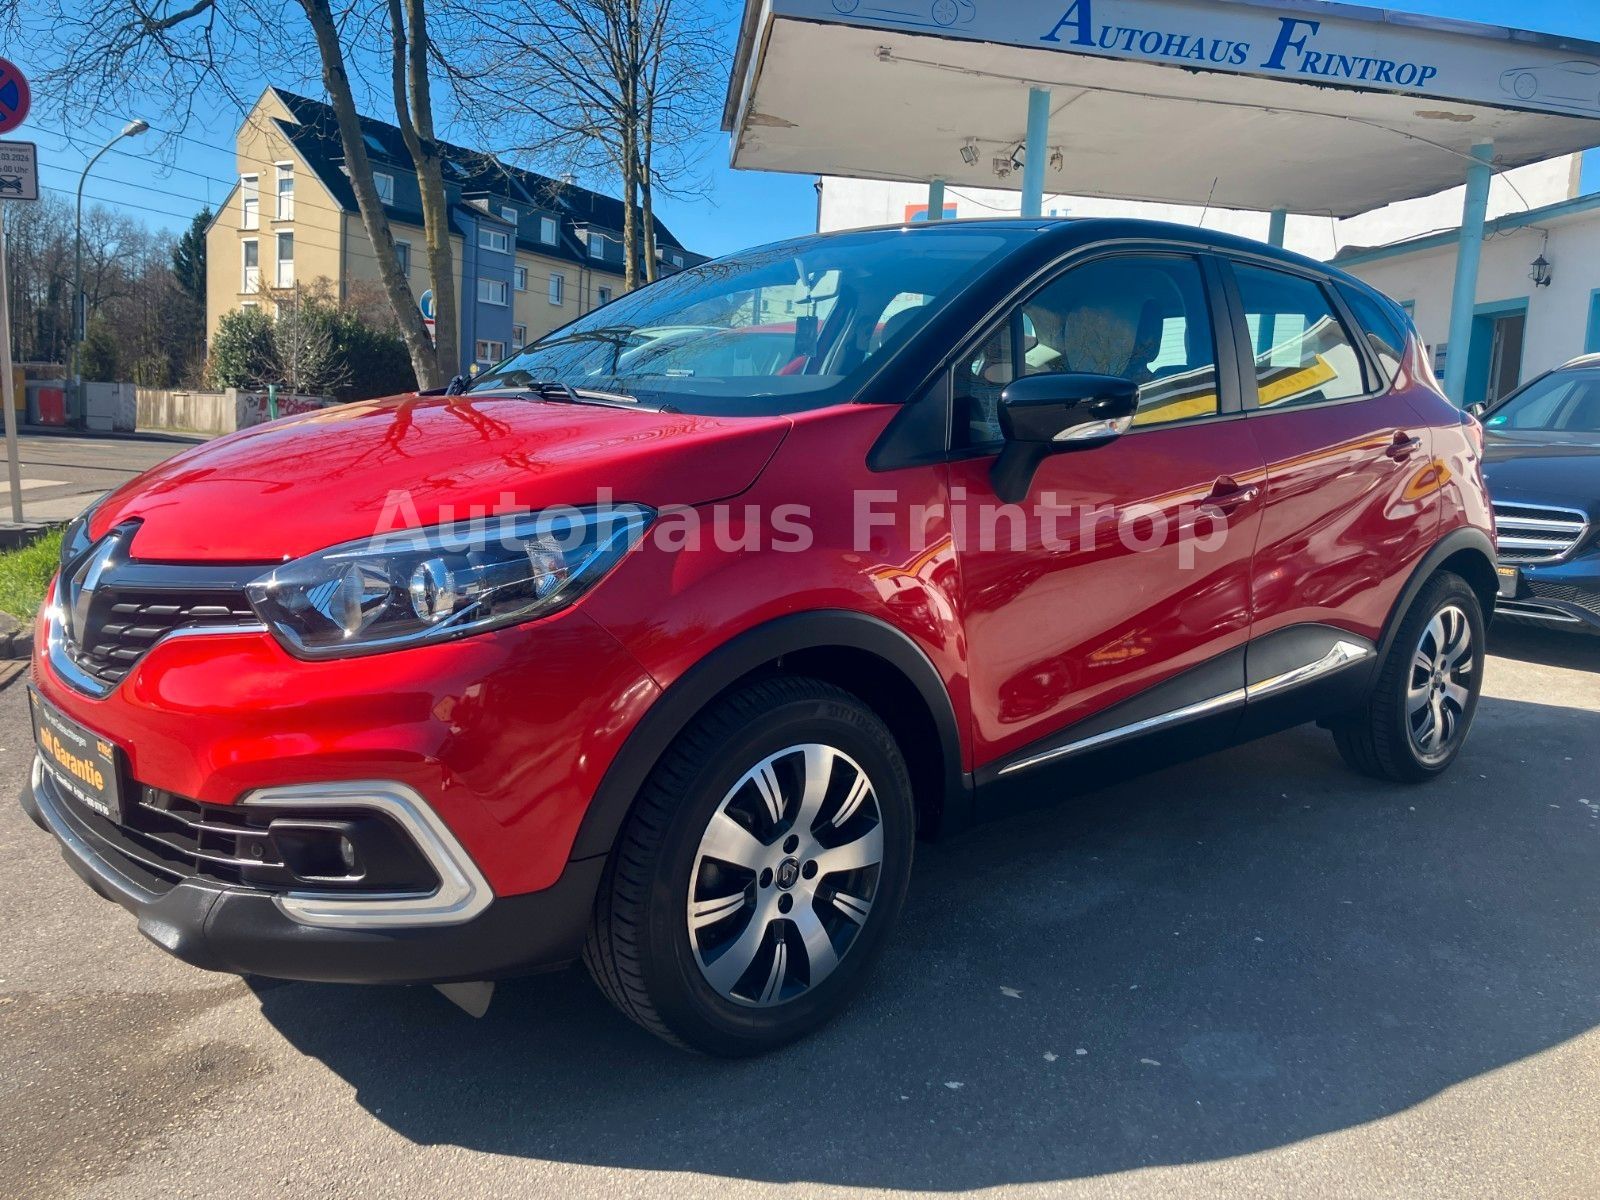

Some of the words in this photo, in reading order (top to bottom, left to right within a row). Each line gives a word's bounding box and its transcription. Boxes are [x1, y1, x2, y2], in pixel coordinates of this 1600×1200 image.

[1259, 17, 1437, 88] FRINTROP
[14, 165, 29, 174] Uhr
[40, 727, 53, 755] mit
[53, 736, 104, 791] Garantie
